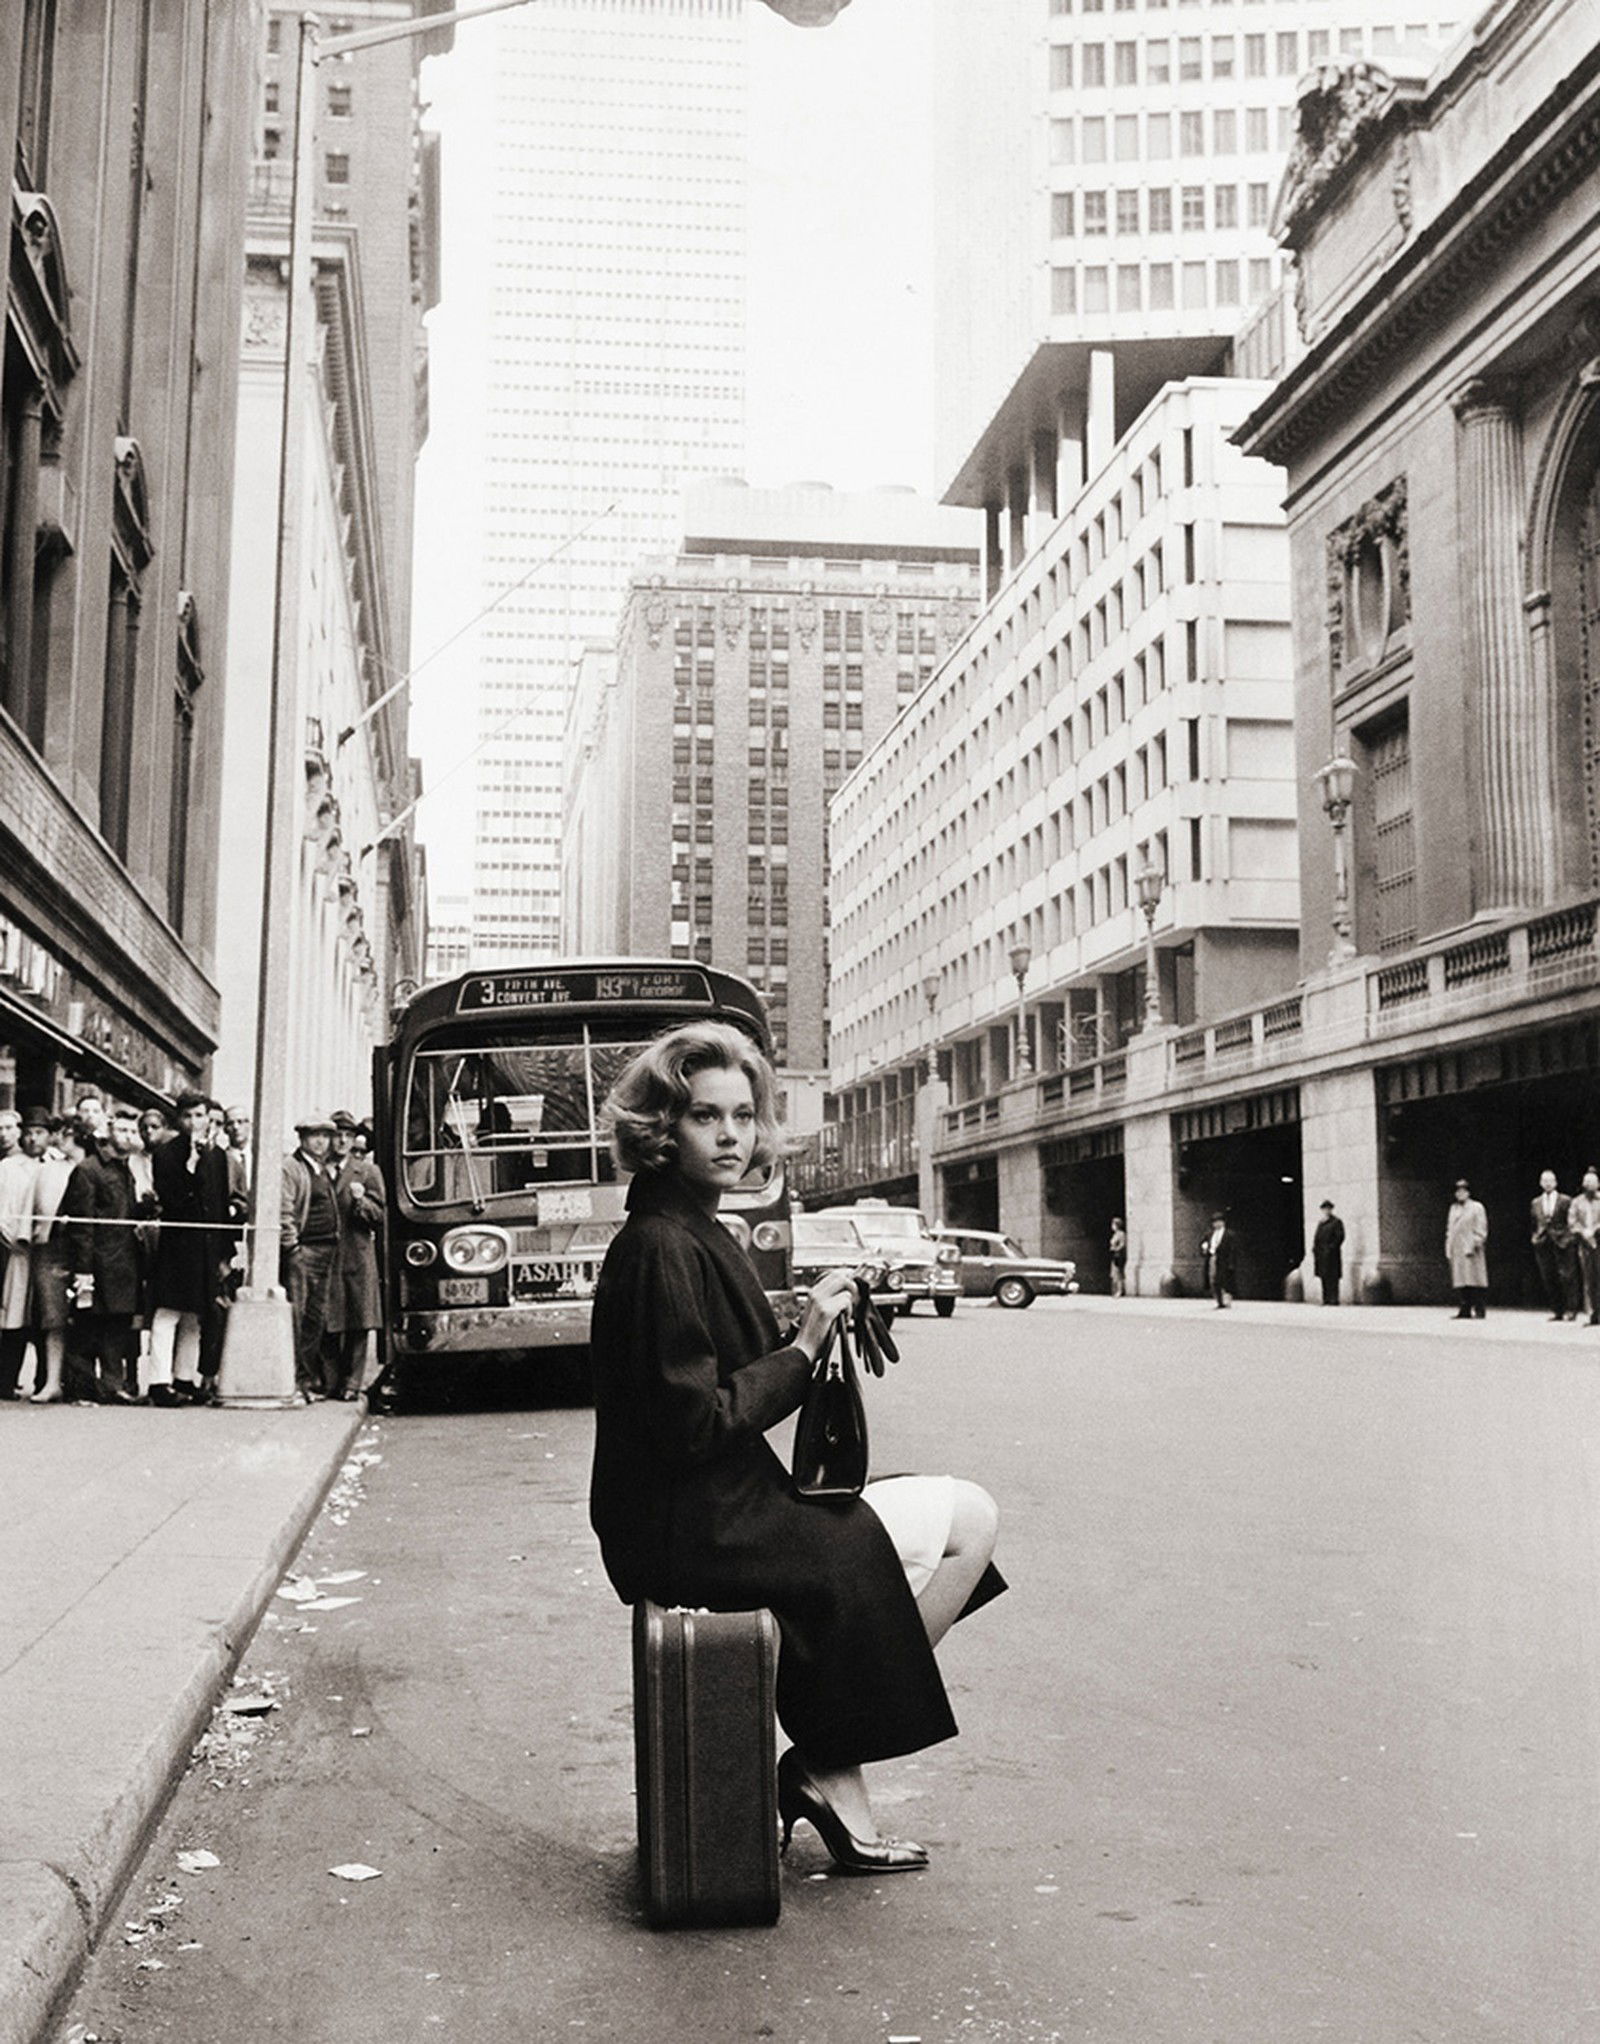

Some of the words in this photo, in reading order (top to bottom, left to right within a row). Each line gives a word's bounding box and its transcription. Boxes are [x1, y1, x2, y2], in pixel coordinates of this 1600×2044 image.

[643, 973, 681, 985] FORT
[480, 979, 495, 1004] 3
[497, 991, 545, 1004] CONVENT
[517, 1262, 584, 1282] ASAHI
